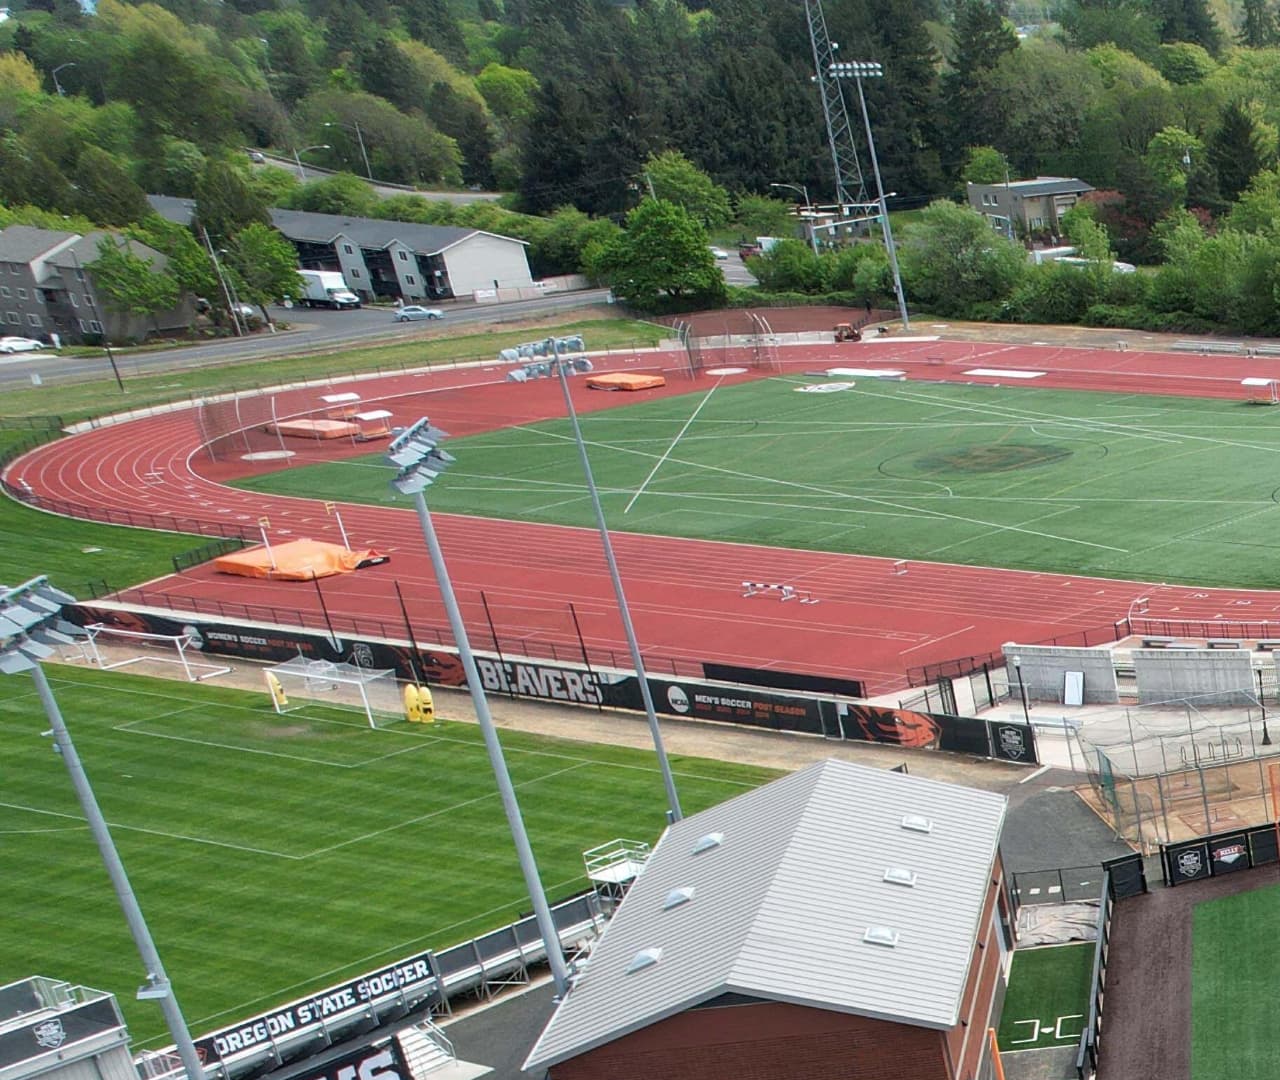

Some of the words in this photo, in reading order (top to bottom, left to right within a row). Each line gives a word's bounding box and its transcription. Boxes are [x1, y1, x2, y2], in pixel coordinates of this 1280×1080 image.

[477, 659, 603, 704] BEAVERS
[695, 693, 719, 705] MEN'S
[720, 696, 752, 710] SOCCER
[214, 1011, 296, 1056] OREGON
[297, 988, 357, 1024] STATE
[357, 959, 430, 1000] SOCCER
